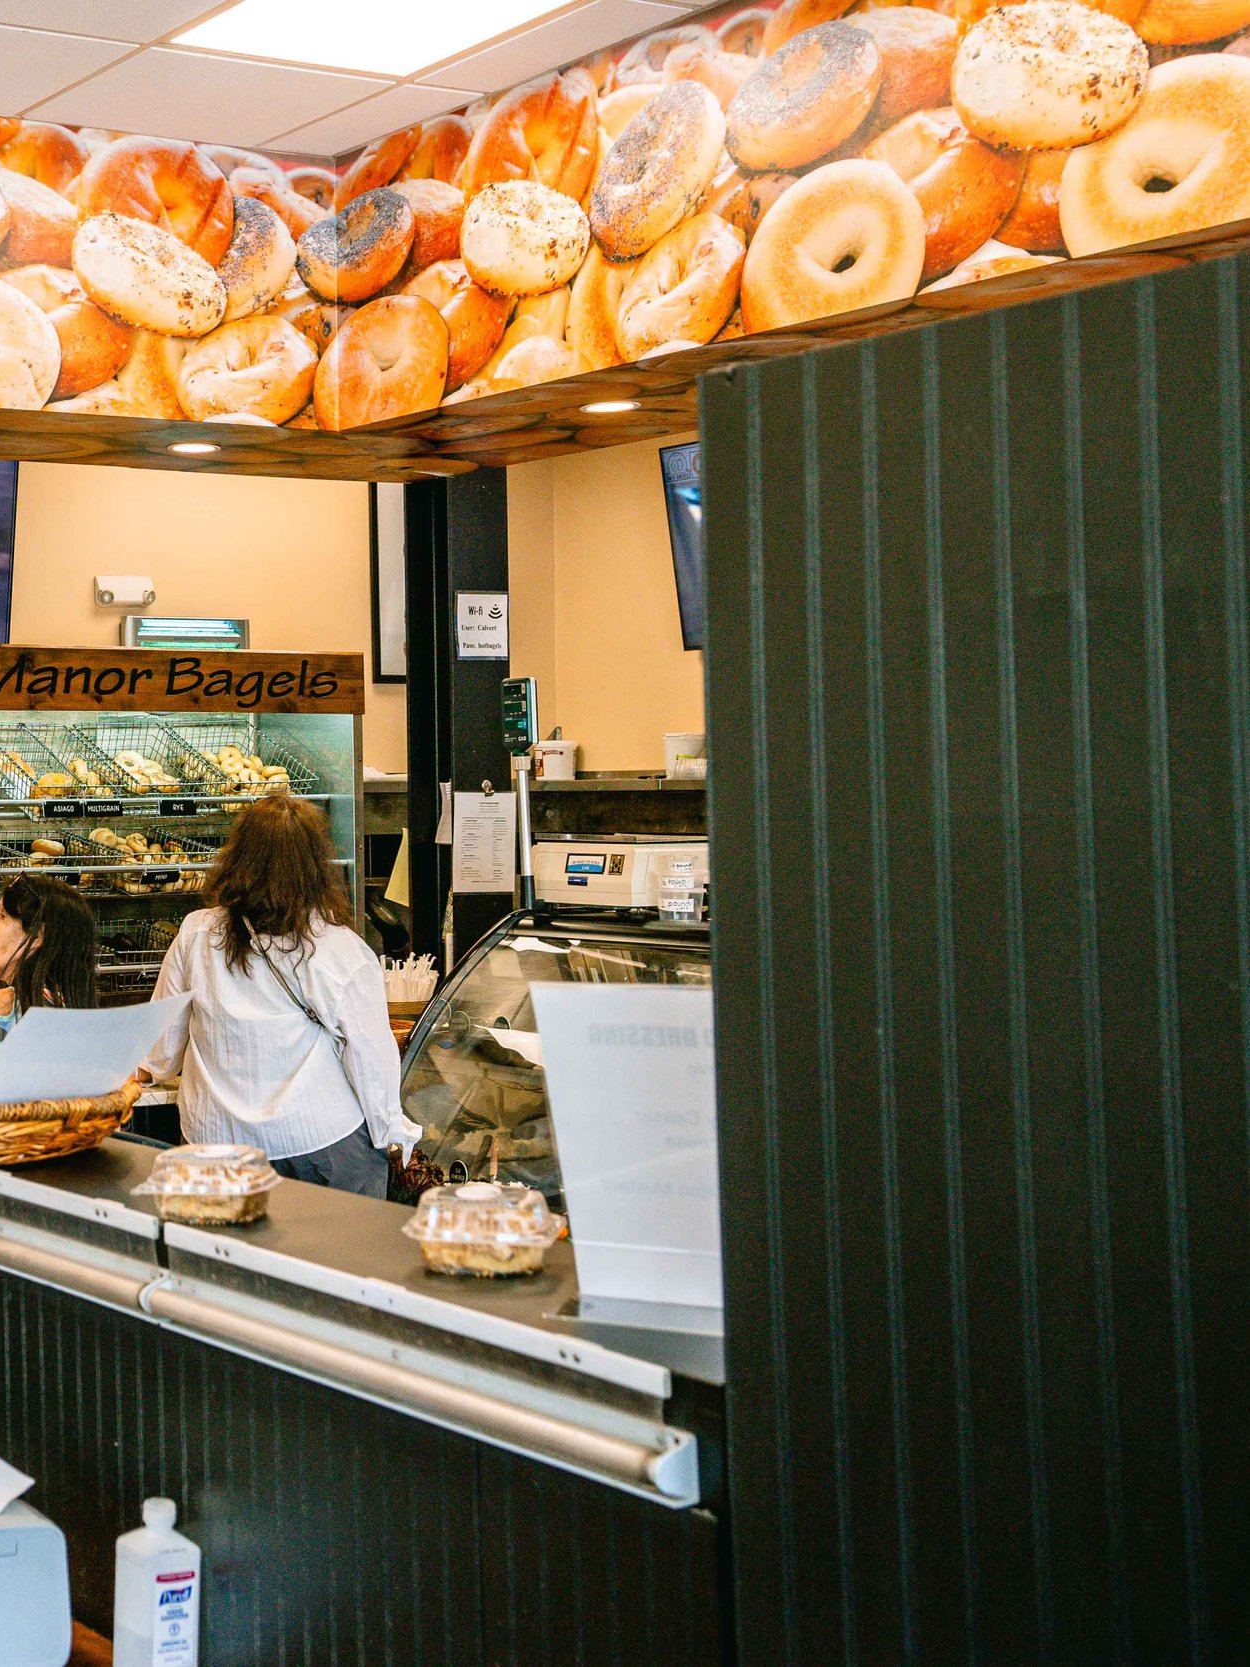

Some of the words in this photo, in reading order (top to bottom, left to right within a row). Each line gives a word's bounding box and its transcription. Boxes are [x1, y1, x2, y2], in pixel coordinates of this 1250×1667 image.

[468, 605, 484, 616] Wi-fi
[477, 624, 497, 632] Calvert
[165, 657, 339, 710] Bagels
[87, 804, 121, 813] MULTIGRAIN
[172, 803, 184, 811] RYE
